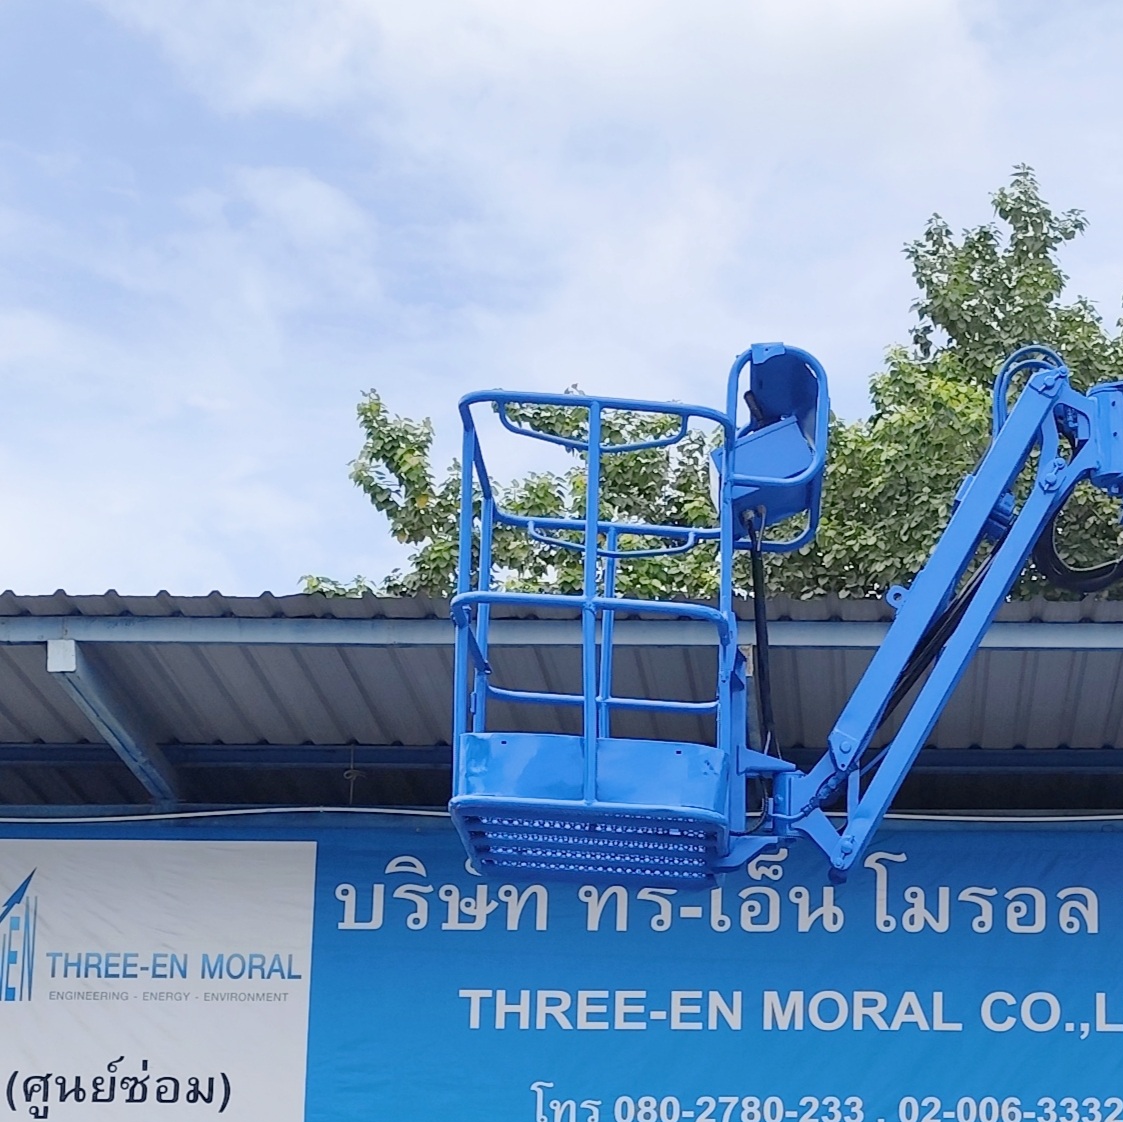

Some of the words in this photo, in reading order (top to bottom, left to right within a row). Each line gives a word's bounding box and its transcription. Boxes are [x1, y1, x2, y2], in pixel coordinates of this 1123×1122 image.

[864, 851, 1099, 935] โมรอล
[46, 952, 188, 979] THREE-EN
[201, 953, 303, 980] MORAL
[49, 991, 129, 1001] ENGINEERING
[142, 991, 191, 1002] ENERGY
[203, 992, 290, 1002] ENVIRONMENT
[458, 989, 742, 1031] THREE-EN
[763, 990, 963, 1032] MORAL
[6, 1055, 231, 1119] (ศูนย์ซ่อม)
